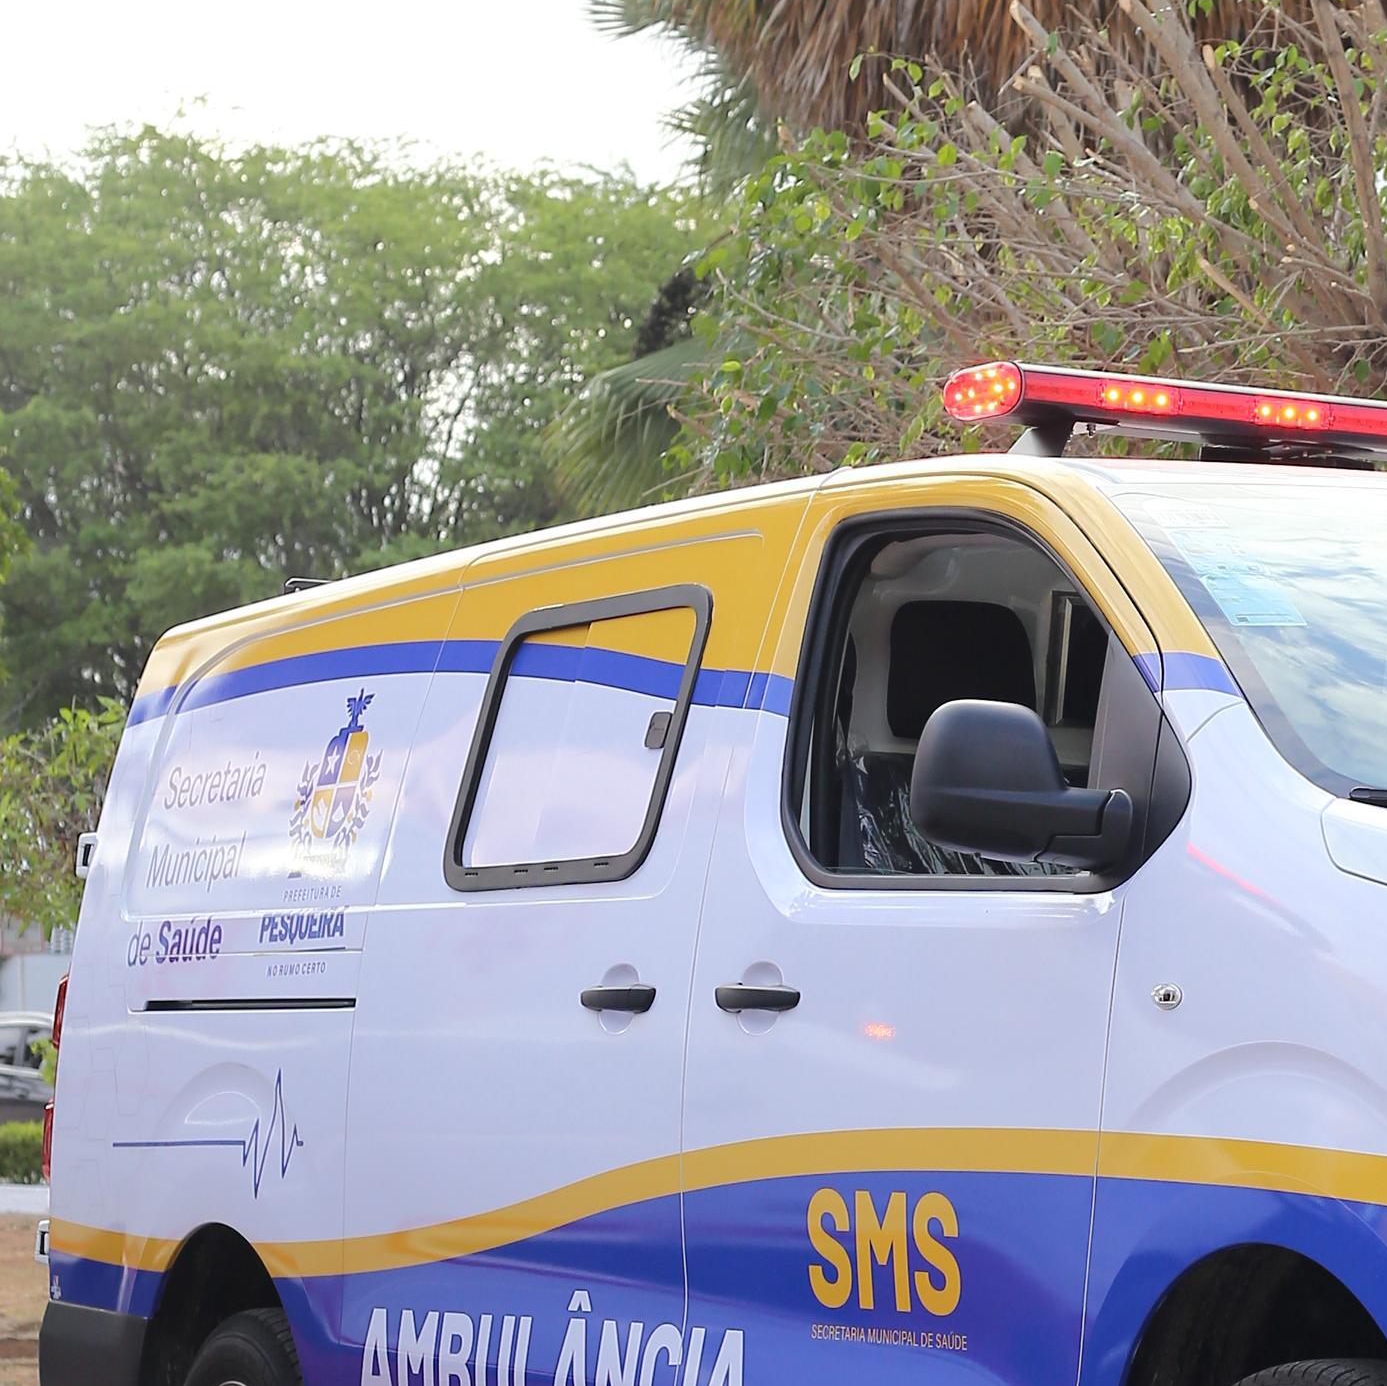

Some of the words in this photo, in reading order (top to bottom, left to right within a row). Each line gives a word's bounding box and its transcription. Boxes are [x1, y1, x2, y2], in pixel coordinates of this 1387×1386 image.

[164, 751, 267, 810] Secretaria
[146, 831, 247, 893] Municipal
[283, 886, 329, 903] PREFEITURA
[331, 885, 342, 898] DE
[127, 920, 152, 967] de
[155, 916, 222, 965] Saúde
[259, 907, 345, 945] PESQUEIRA
[267, 965, 277, 977] NO
[279, 963, 300, 976] RUMO
[301, 961, 327, 975] CERTO
[806, 1187, 962, 1317] SMS
[811, 1324, 866, 1343] SECRETARIA
[867, 1328, 918, 1347] MUNICIPAL
[920, 1332, 933, 1348] DE
[935, 1331, 968, 1351] SAÚDE
